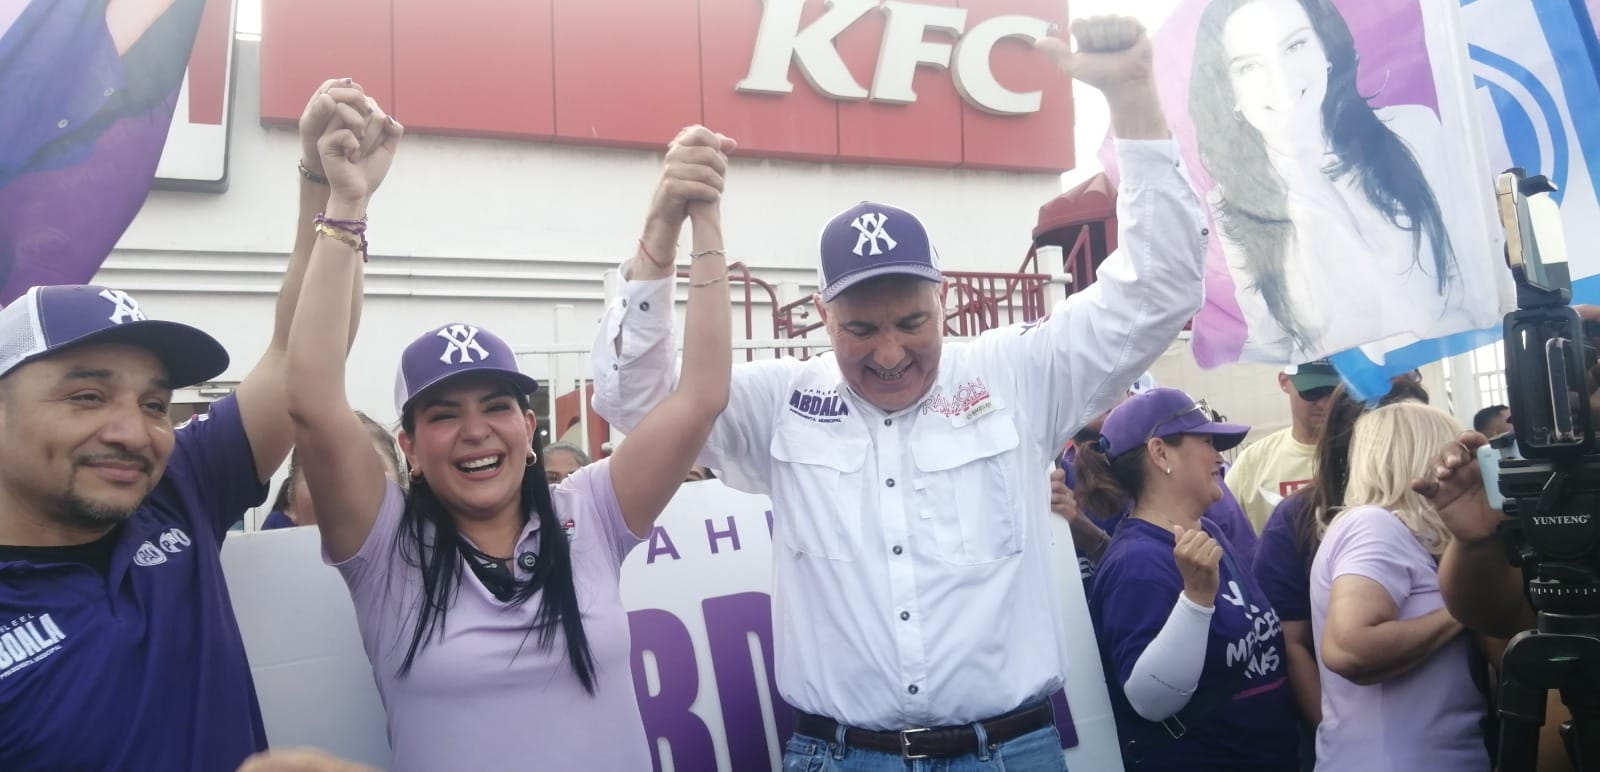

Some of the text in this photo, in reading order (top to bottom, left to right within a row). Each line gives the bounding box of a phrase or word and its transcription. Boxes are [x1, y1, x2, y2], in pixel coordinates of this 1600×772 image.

[735, 0, 1050, 115] KFC
[788, 388, 849, 417] ABDALA
[803, 388, 838, 396] YAHLEE
[1532, 514, 1588, 525] YUNTENG
[0, 613, 66, 671] BDALA
